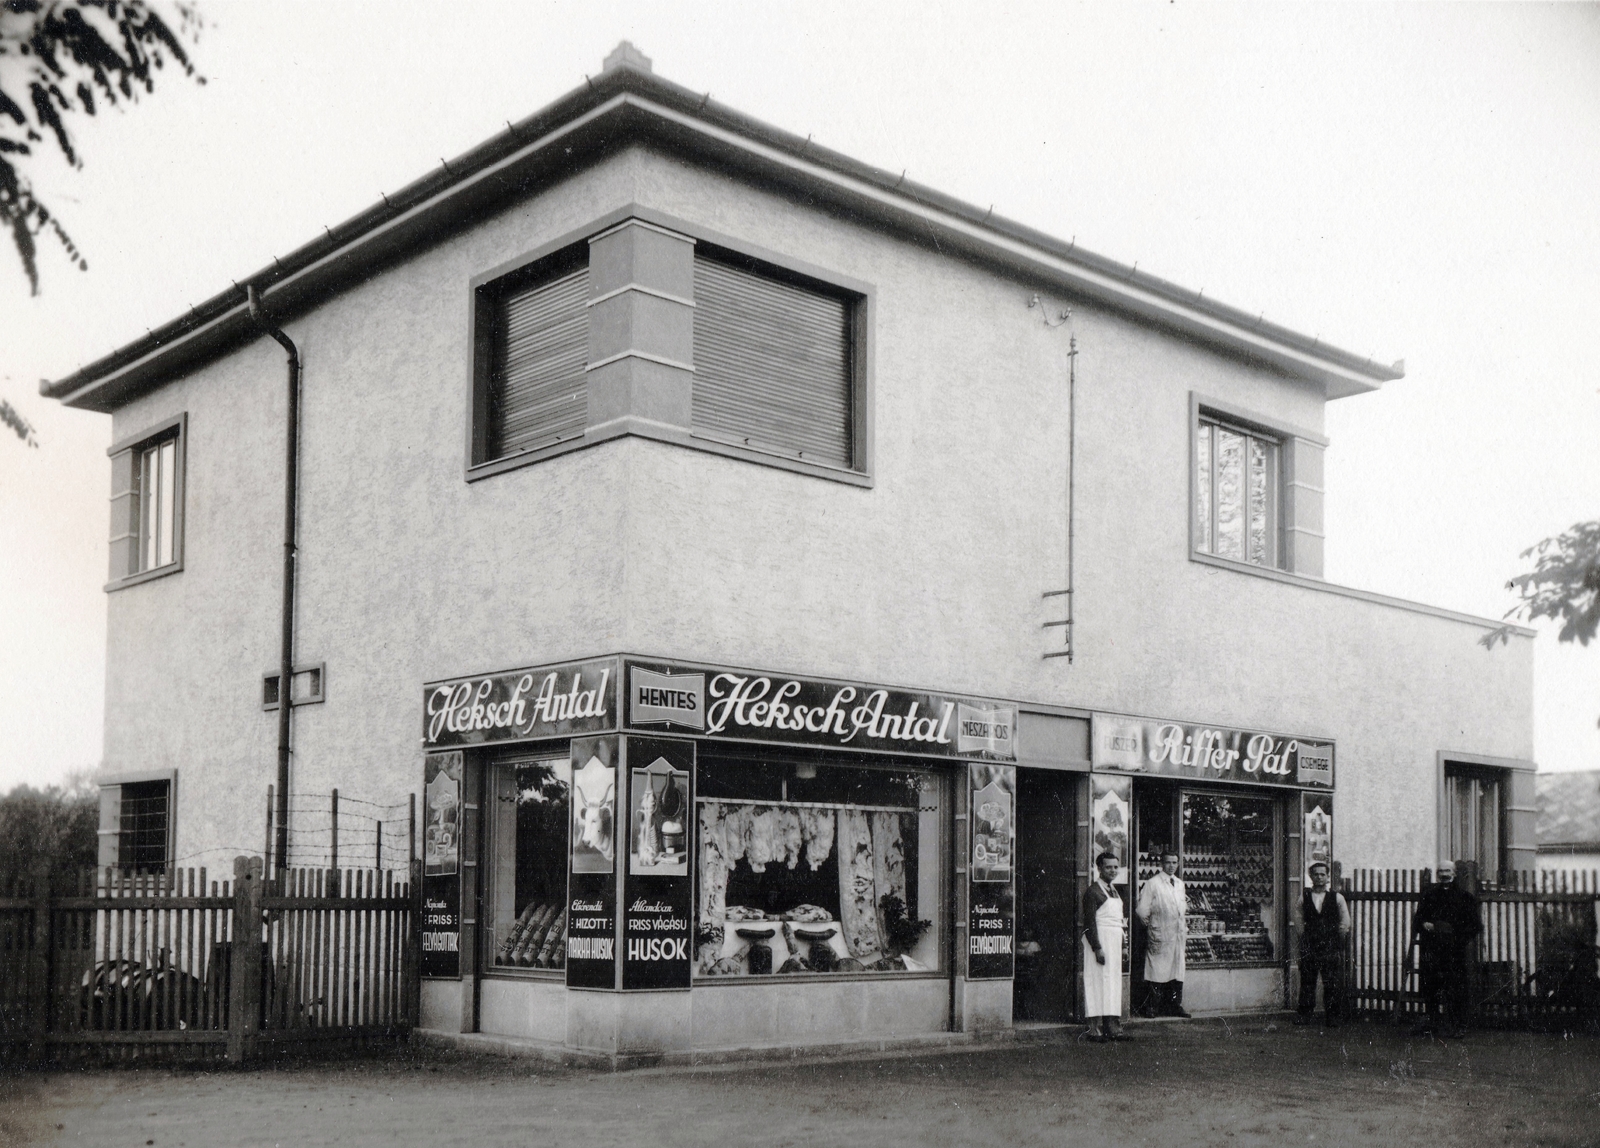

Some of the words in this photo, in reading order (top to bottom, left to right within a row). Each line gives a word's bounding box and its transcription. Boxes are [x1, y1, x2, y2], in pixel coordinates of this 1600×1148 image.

[427, 674, 533, 743] Heksch
[523, 668, 610, 734] Antal
[639, 687, 697, 710] HENTES
[706, 673, 856, 736] Heksch
[841, 689, 952, 744] Antal
[962, 716, 1008, 740] MÉSZÁOS
[1150, 724, 1240, 770] Riffer
[1243, 734, 1298, 775] Pál
[1301, 756, 1328, 771] CSEMEGE
[428, 915, 452, 925] FRISS
[629, 918, 651, 930] FRISS
[979, 919, 1003, 929] FRISS
[591, 938, 614, 961] HUSOK
[628, 938, 688, 961] HUSOK
